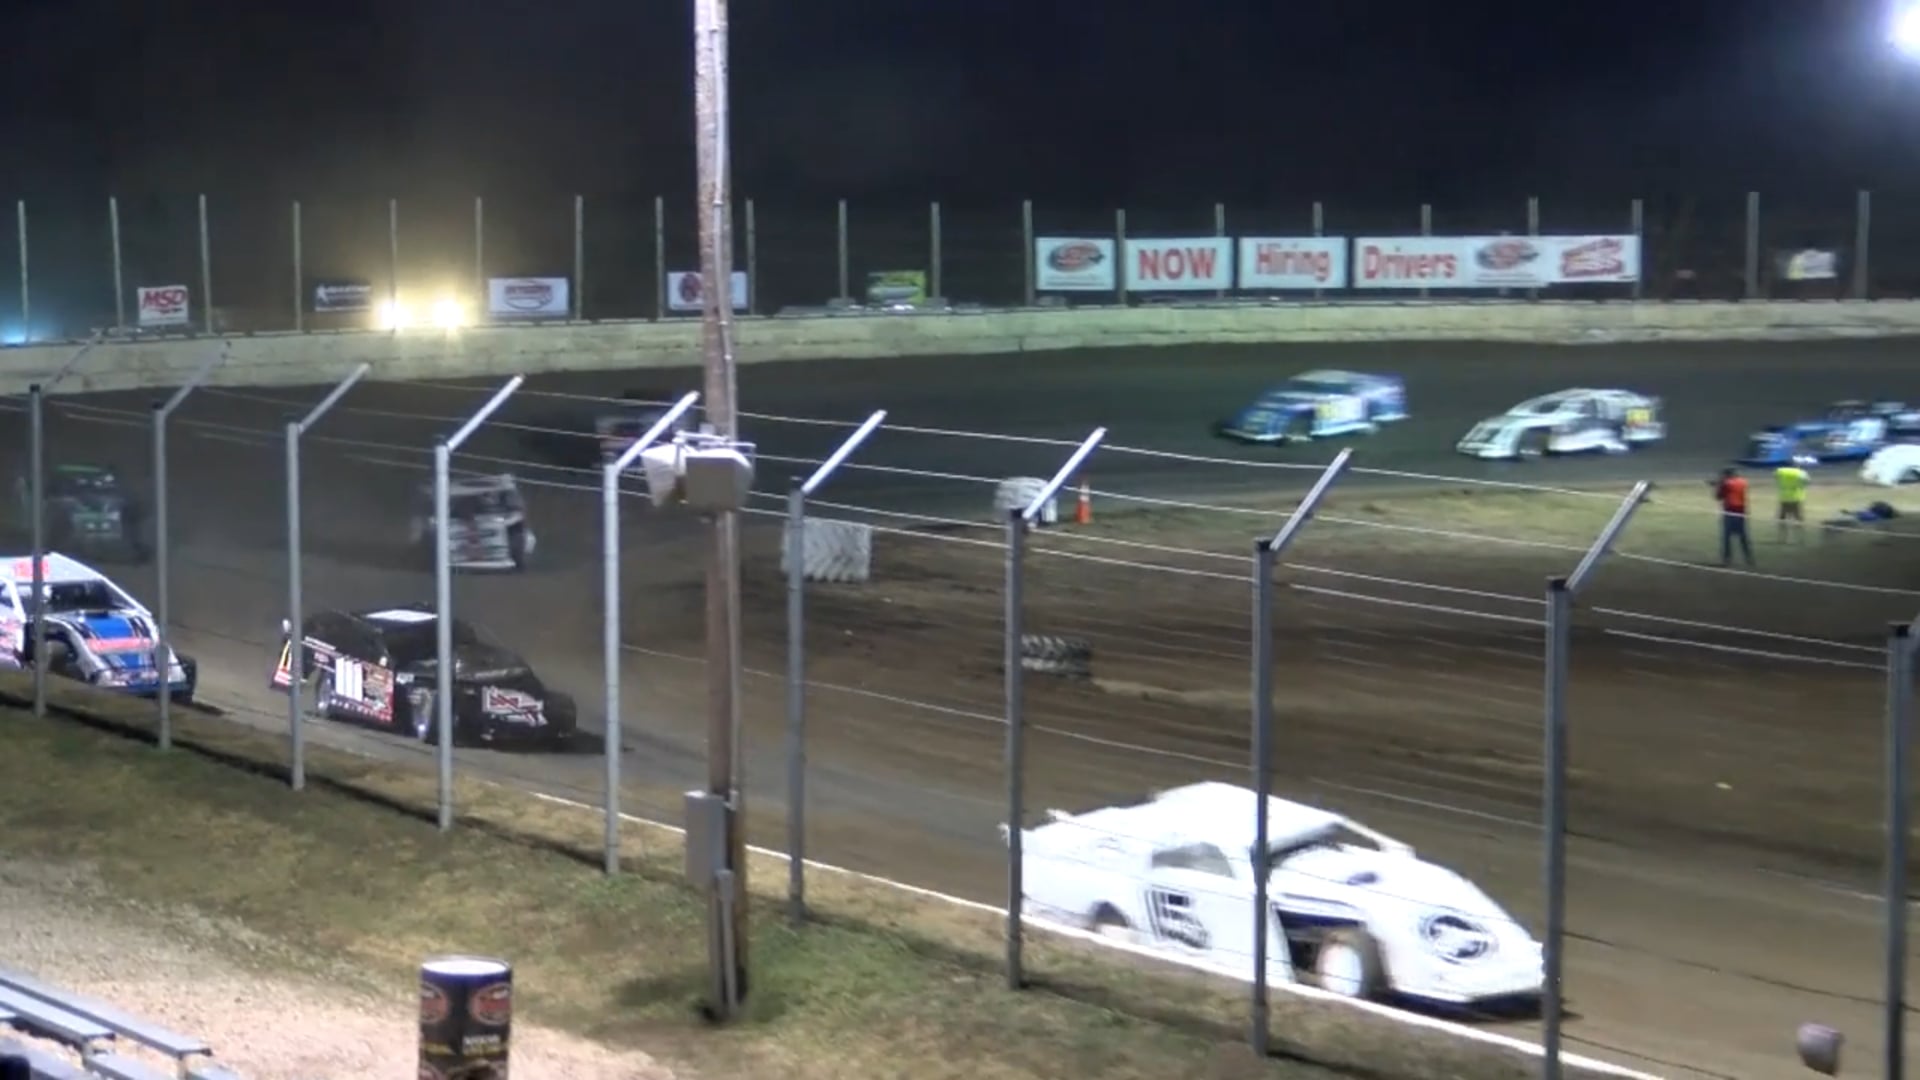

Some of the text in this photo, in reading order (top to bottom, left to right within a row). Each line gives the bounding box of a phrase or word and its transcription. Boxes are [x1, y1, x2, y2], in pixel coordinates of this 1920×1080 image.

[1138, 247, 1216, 280] NOW
[1256, 243, 1330, 283] Hiring
[1363, 245, 1457, 280] Drivers
[143, 289, 186, 308] MSD
